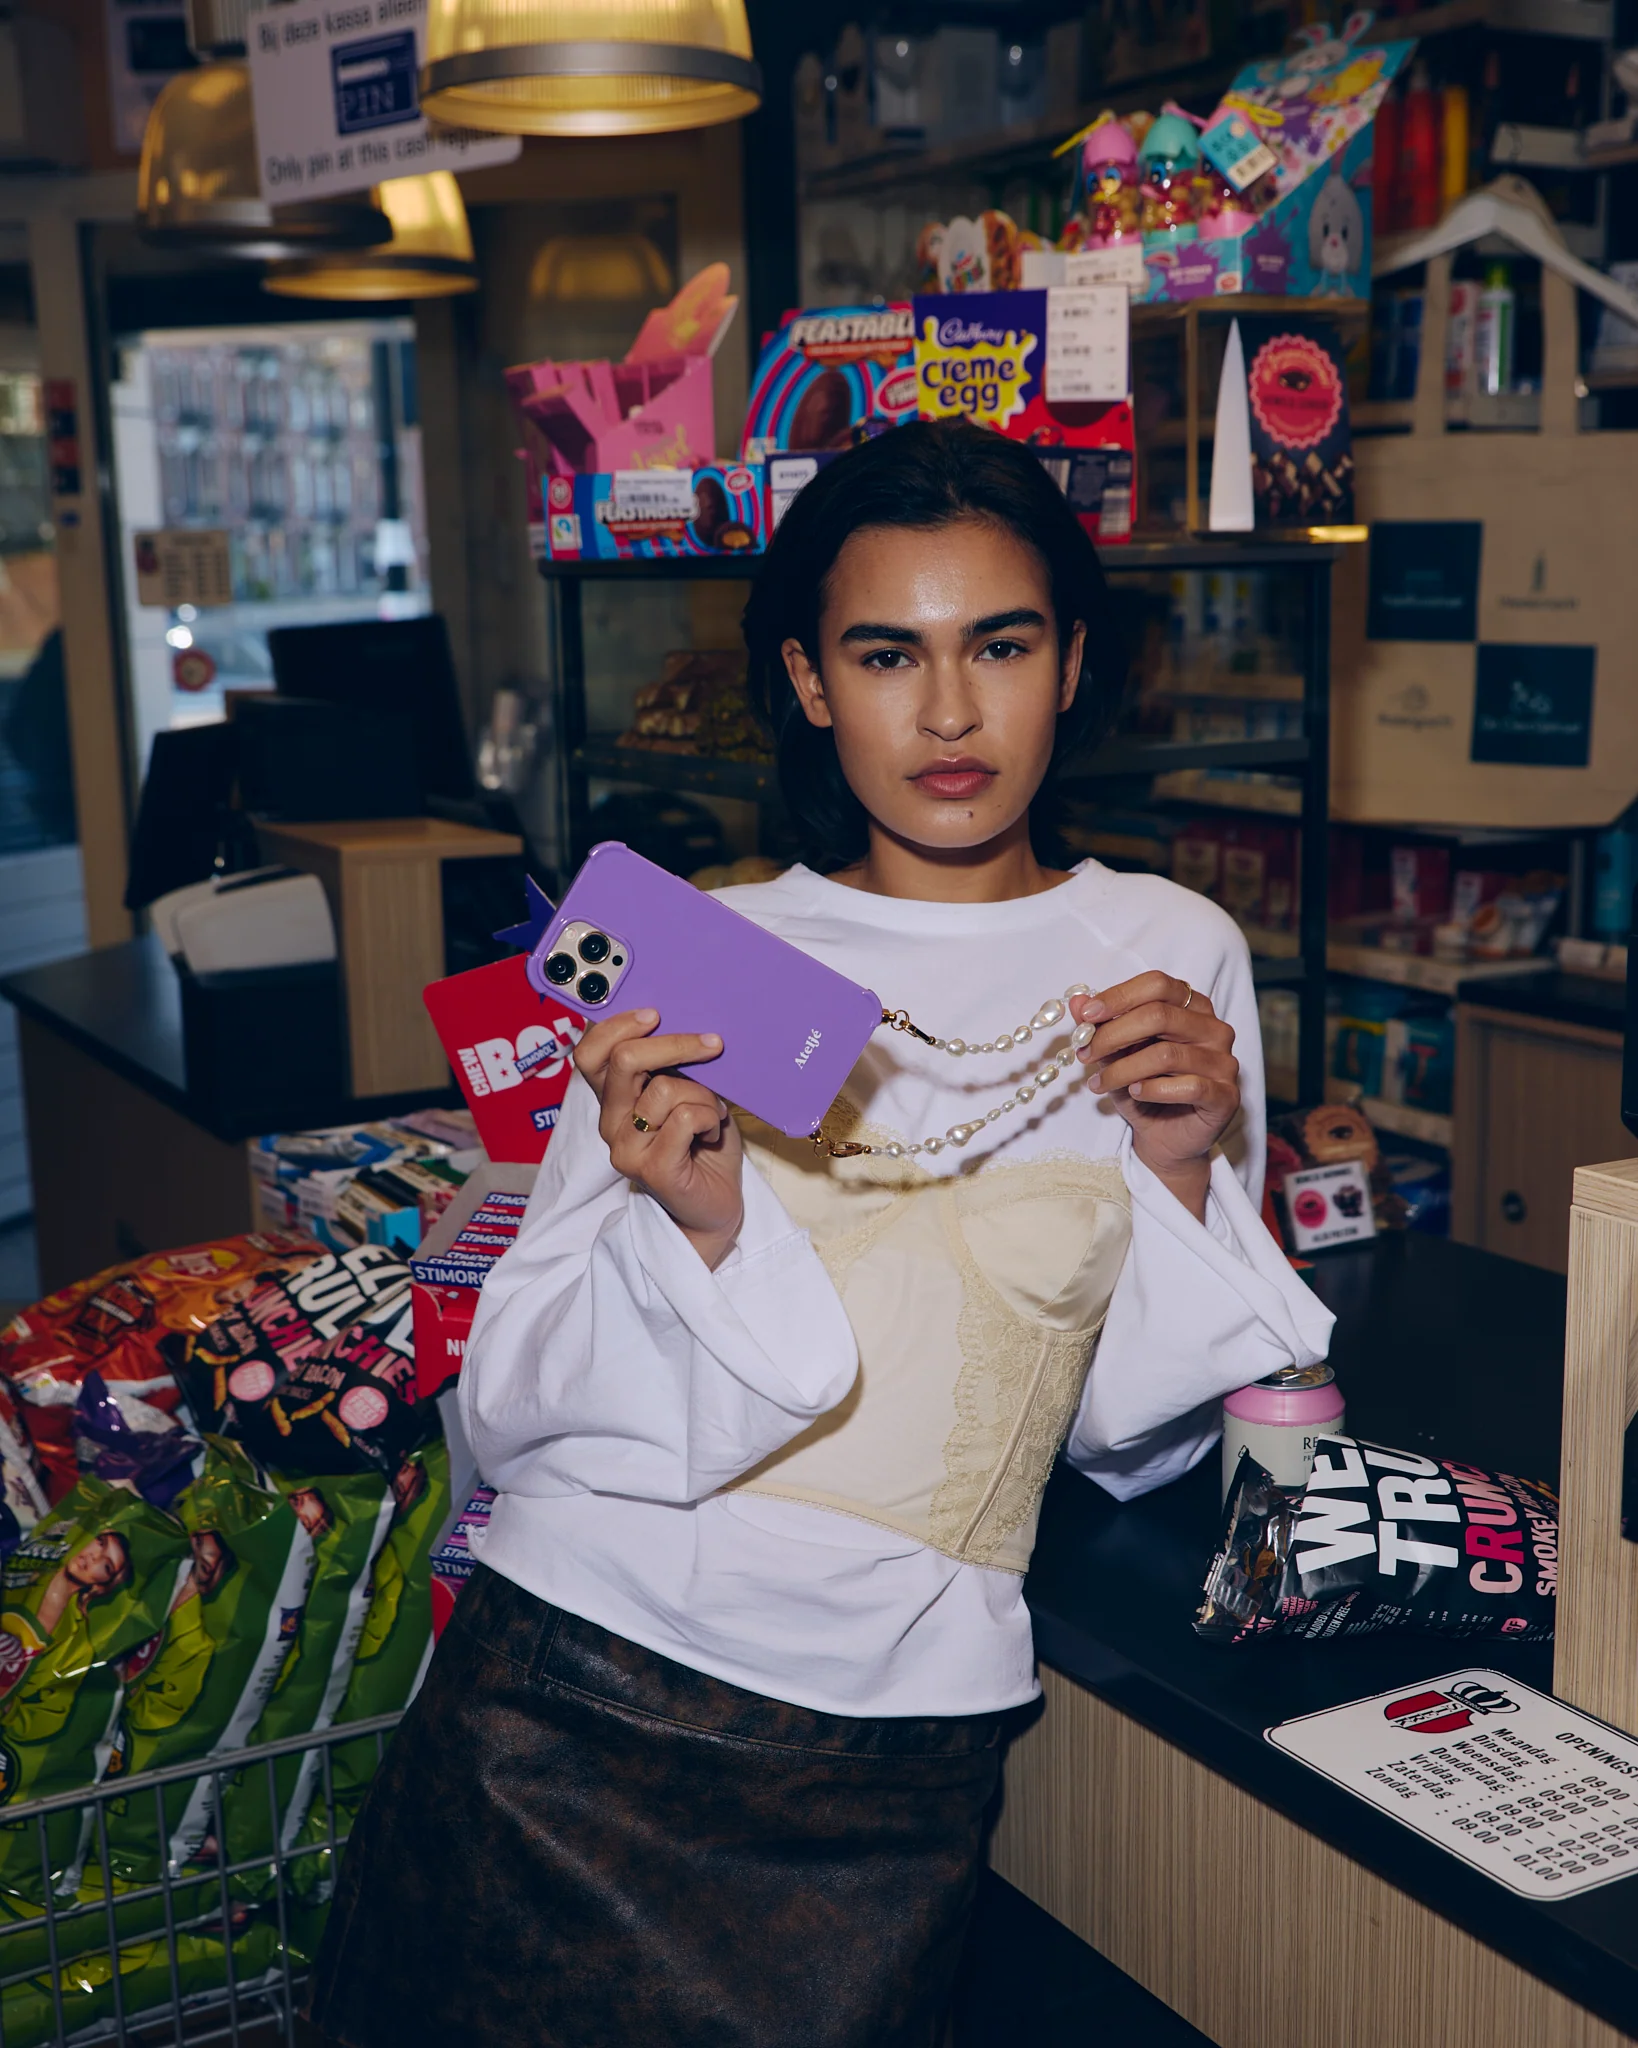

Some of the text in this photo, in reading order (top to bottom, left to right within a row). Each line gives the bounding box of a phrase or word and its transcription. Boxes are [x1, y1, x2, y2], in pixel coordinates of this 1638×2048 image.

[266, 155, 304, 187] Only
[306, 153, 333, 181] pin
[939, 318, 1004, 347] Cadbury
[921, 356, 1016, 391] creme
[938, 382, 1000, 413] egg
[457, 1047, 491, 1097] CHEW
[794, 1028, 823, 1070] Ateljé
[1440, 1459, 1525, 1594] CRUNC
[1525, 1507, 1559, 1596] SMOKEY
[1452, 1693, 1487, 1714] AMSTERDAM
[1451, 1740, 1526, 1782] Woensdag
[1539, 1790, 1588, 1814] 09.00
[1601, 1824, 1638, 1850] 01.0
[1471, 1734, 1532, 1767] Dinsdag
[1560, 1783, 1609, 1807] 09.00
[1491, 1728, 1559, 1764] Maandag
[1581, 1776, 1630, 1800] 09.00
[1365, 1767, 1420, 1799] Zondag
[1451, 1818, 1500, 1844] 09.00
[1513, 1854, 1563, 1881] 01.00
[1386, 1760, 1455, 1799] Zaterdag
[1473, 1811, 1522, 1836] 09.00
[1535, 1847, 1587, 1875] 02.00
[1409, 1754, 1464, 1785] Vrijdag
[1496, 1804, 1545, 1829] 09.00
[1558, 1839, 1609, 1866] 02.00
[1429, 1747, 1509, 1791] Donderdag
[1517, 1797, 1566, 1822] 09.00
[1580, 1832, 1630, 1858] 01.00
